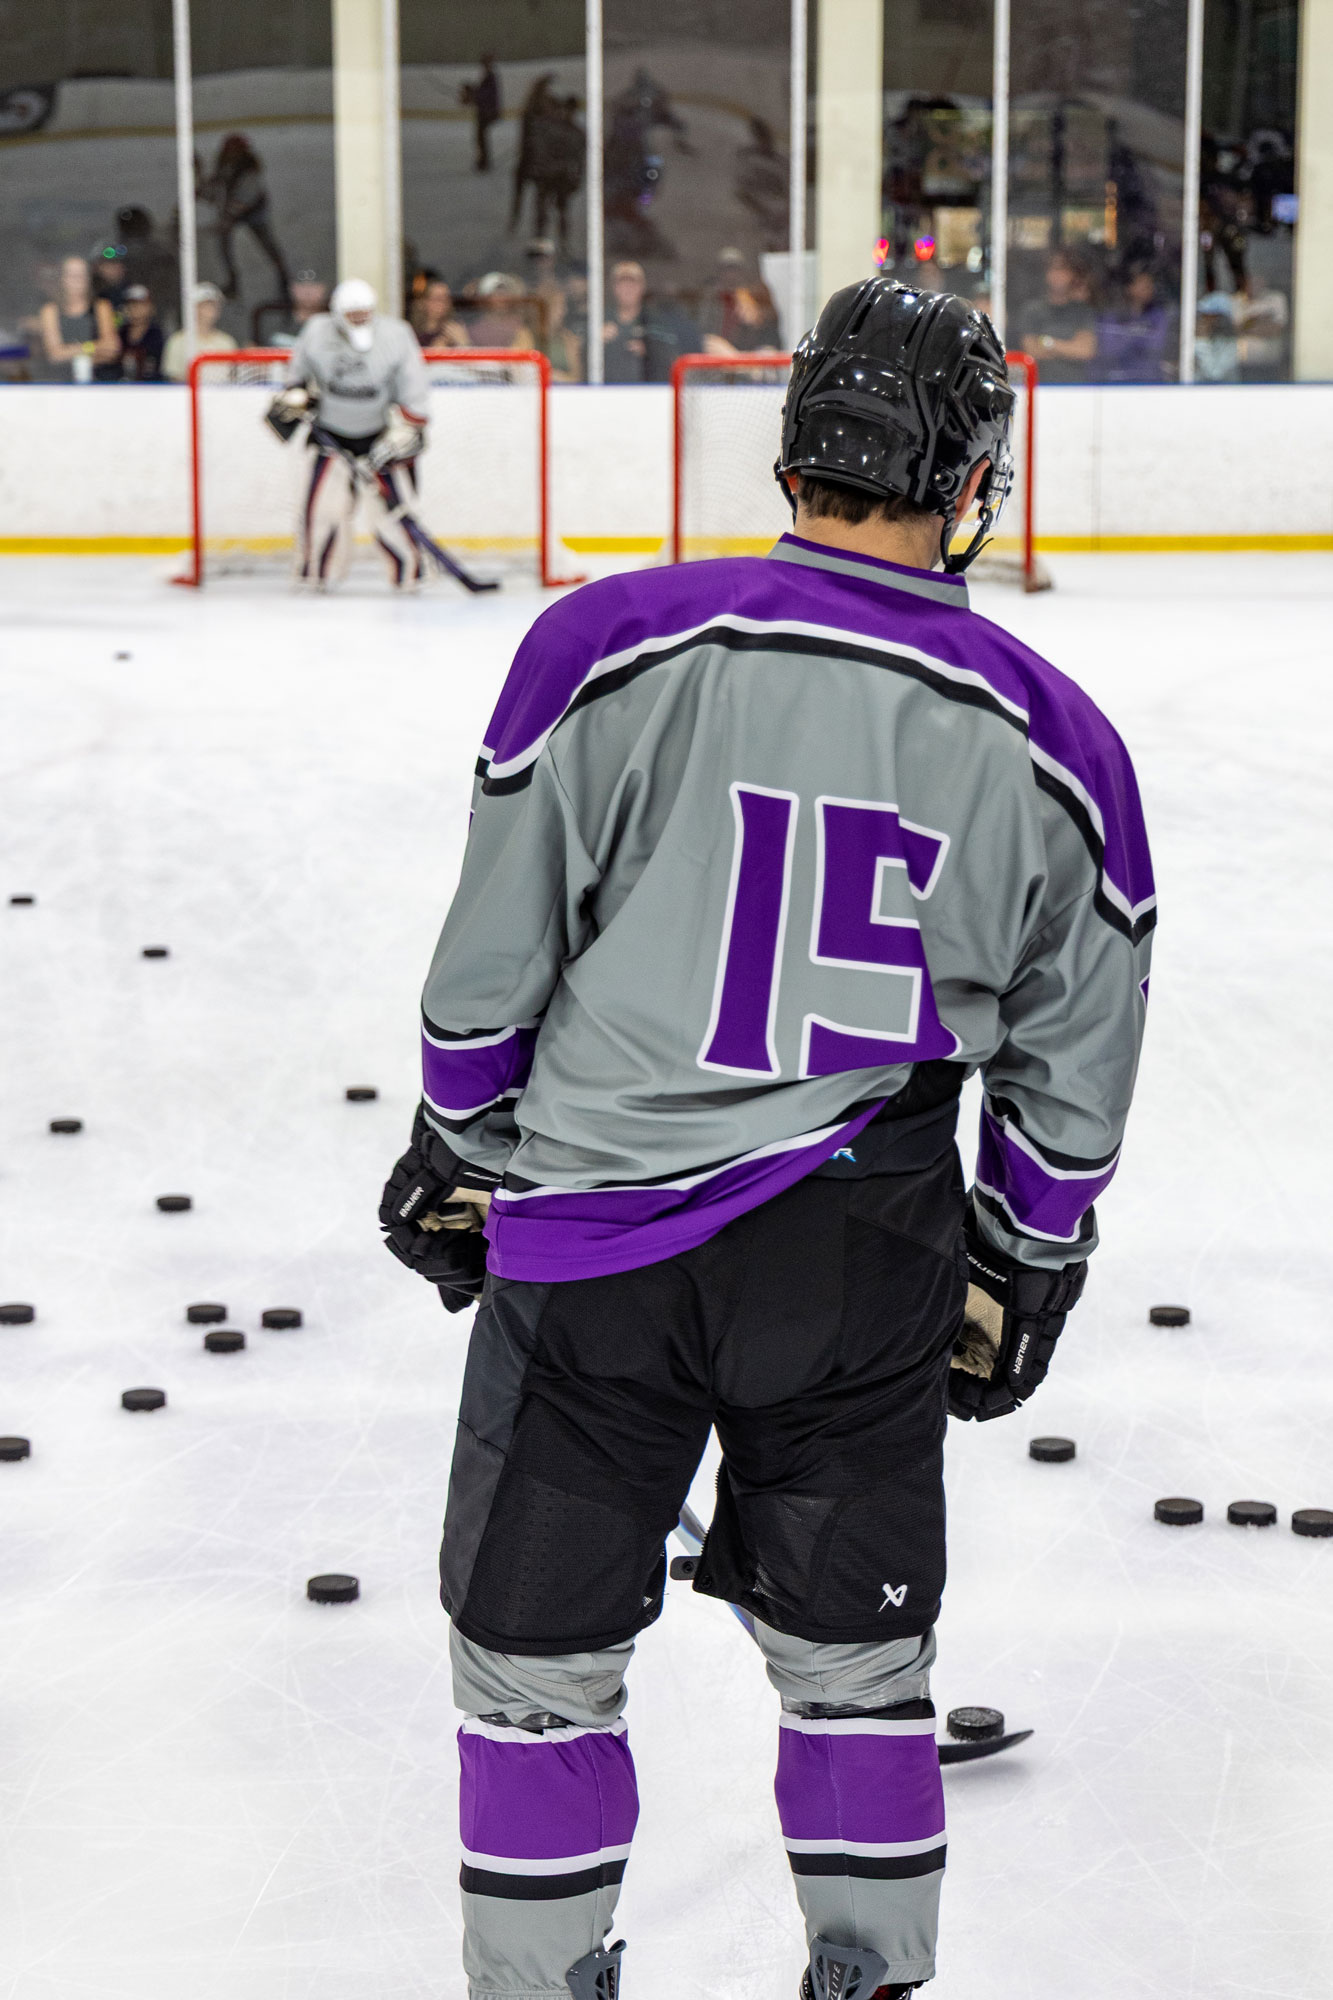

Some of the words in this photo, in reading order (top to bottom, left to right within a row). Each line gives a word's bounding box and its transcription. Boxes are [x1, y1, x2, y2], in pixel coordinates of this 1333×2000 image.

[697, 782, 962, 1079] 15
[966, 1253, 1007, 1283] AUER
[830, 1963, 841, 2000] LITE
